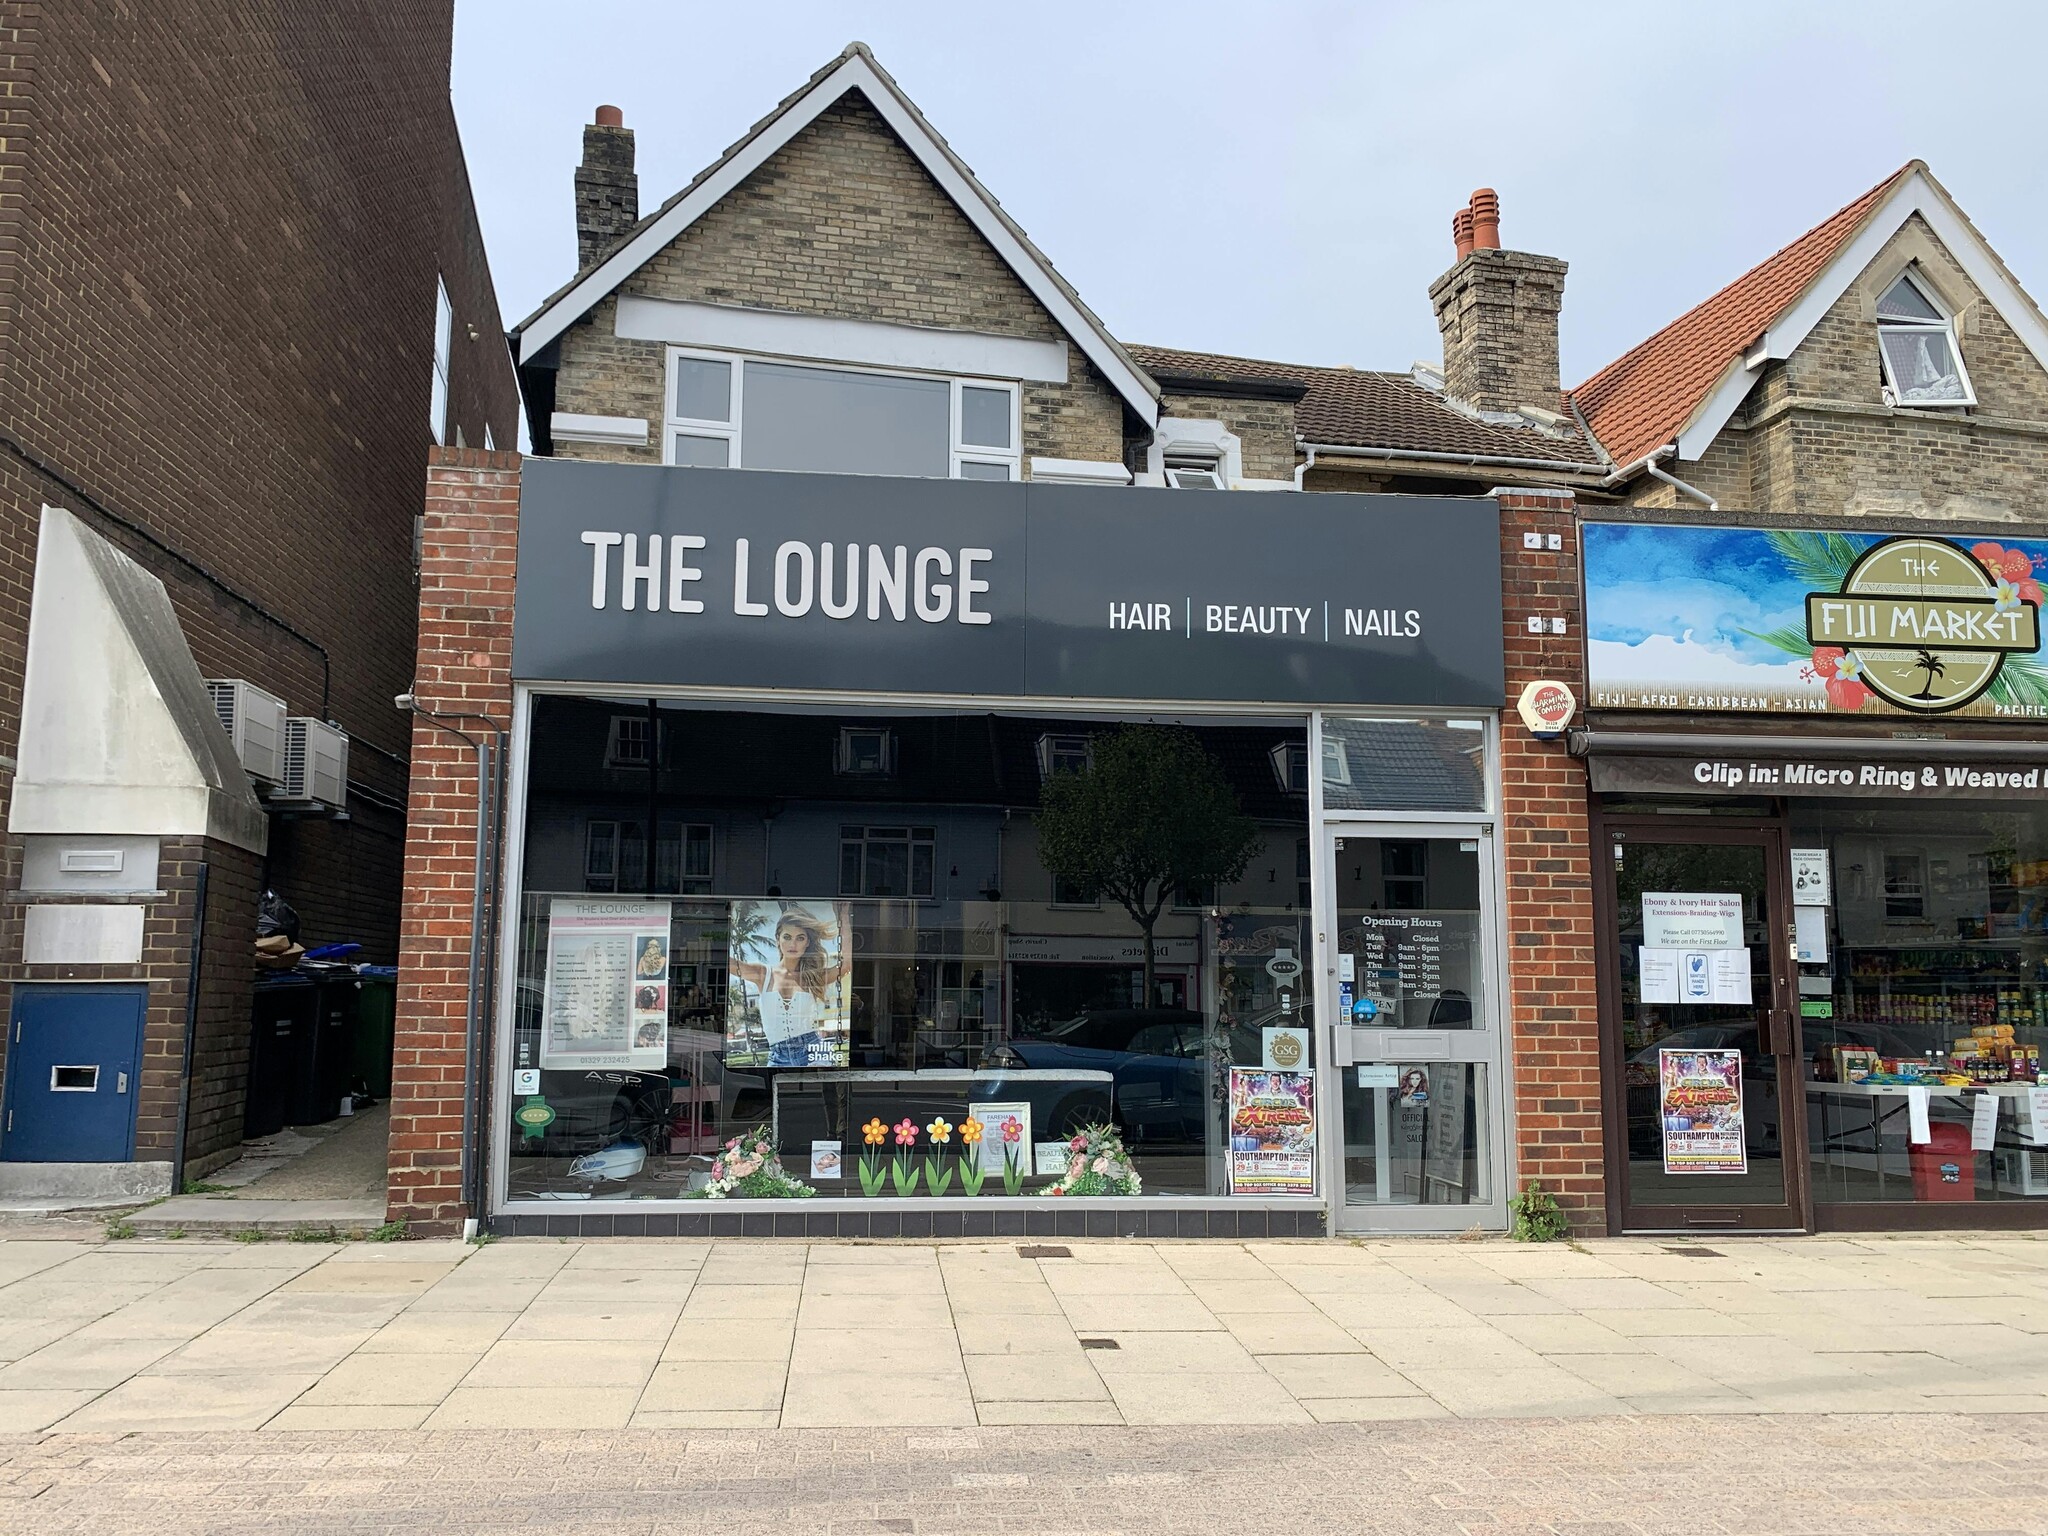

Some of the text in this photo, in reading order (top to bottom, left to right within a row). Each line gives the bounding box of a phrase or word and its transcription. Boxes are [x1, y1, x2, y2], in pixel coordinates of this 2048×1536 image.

[1901, 558, 1940, 577] THE
[580, 530, 993, 625] THE LOUNGE
[1109, 602, 1421, 638] HAIR BEAUTY NAILS
[1822, 602, 2023, 641] FIJI MARKET
[1531, 692, 1568, 709] ALARMING
[1598, 693, 1625, 705] FIJI
[1641, 694, 1678, 706] AFRO
[1688, 695, 1767, 709] CARIBBEAN
[1785, 698, 1826, 710] ASIAN
[1995, 704, 2047, 716] PACIFIC
[1693, 762, 1743, 787] Clip
[1749, 764, 1779, 783] in:
[1784, 764, 1854, 785] Micro
[1859, 765, 1915, 791] Ring
[1920, 767, 1938, 787] &
[1944, 767, 2038, 788] Weaved
[1644, 898, 1668, 907] Ebony
[1679, 899, 1699, 907] Ivory
[1719, 899, 1741, 907] Salon
[576, 904, 645, 913] THE LOUNGE
[1652, 909, 1735, 917] Extensions-Braiding-Wigs
[1362, 916, 1442, 928] Opening Hours
[1366, 933, 1384, 941] Mon
[1421, 944, 1440, 952] 6pm
[1366, 952, 1384, 960] Wed
[1421, 954, 1440, 962] 9pm
[1422, 963, 1440, 971] 9pm
[1422, 973, 1440, 981] 5pm
[1422, 982, 1440, 990] 3pm
[1373, 1000, 1393, 1010] PEN
[808, 1041, 835, 1052] milk
[1275, 1045, 1298, 1056] GSG
[580, 1056, 630, 1064] 01329 232425
[808, 1051, 843, 1061] shake
[1682, 1079, 1725, 1087] CIRCUS
[1667, 1087, 1738, 1106] EXTREME
[1251, 1098, 1298, 1108] CIRCUS
[1235, 1106, 1311, 1127] EXTREME
[1668, 1132, 1720, 1140] SOUTHAMPTON
[1235, 1152, 1289, 1161] SOUTHAMPTON
